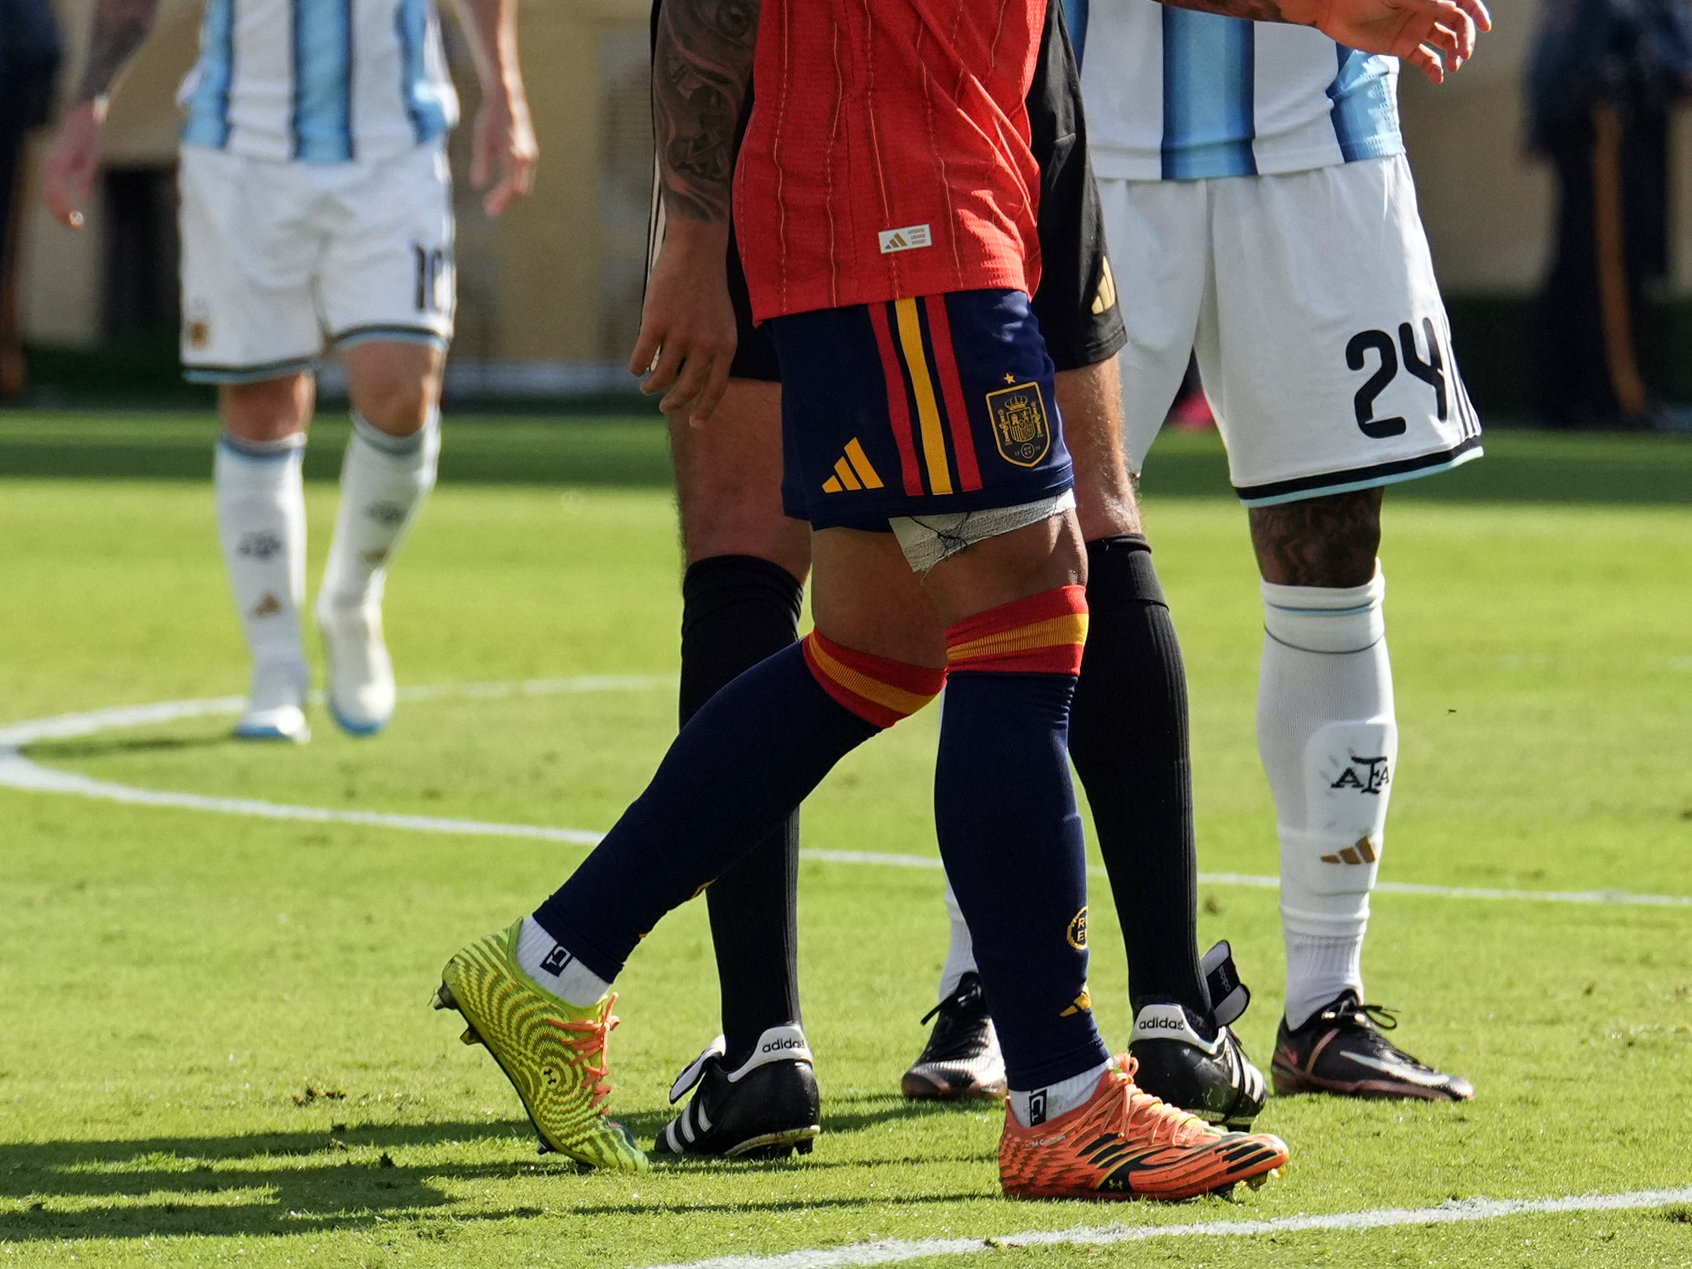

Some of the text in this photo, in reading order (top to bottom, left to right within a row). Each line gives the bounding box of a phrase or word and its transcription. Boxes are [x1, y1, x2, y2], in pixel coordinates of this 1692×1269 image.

[1345, 317, 1448, 439] 24
[1330, 755, 1390, 795] AFA
[1138, 1016, 1184, 1031] adidas
